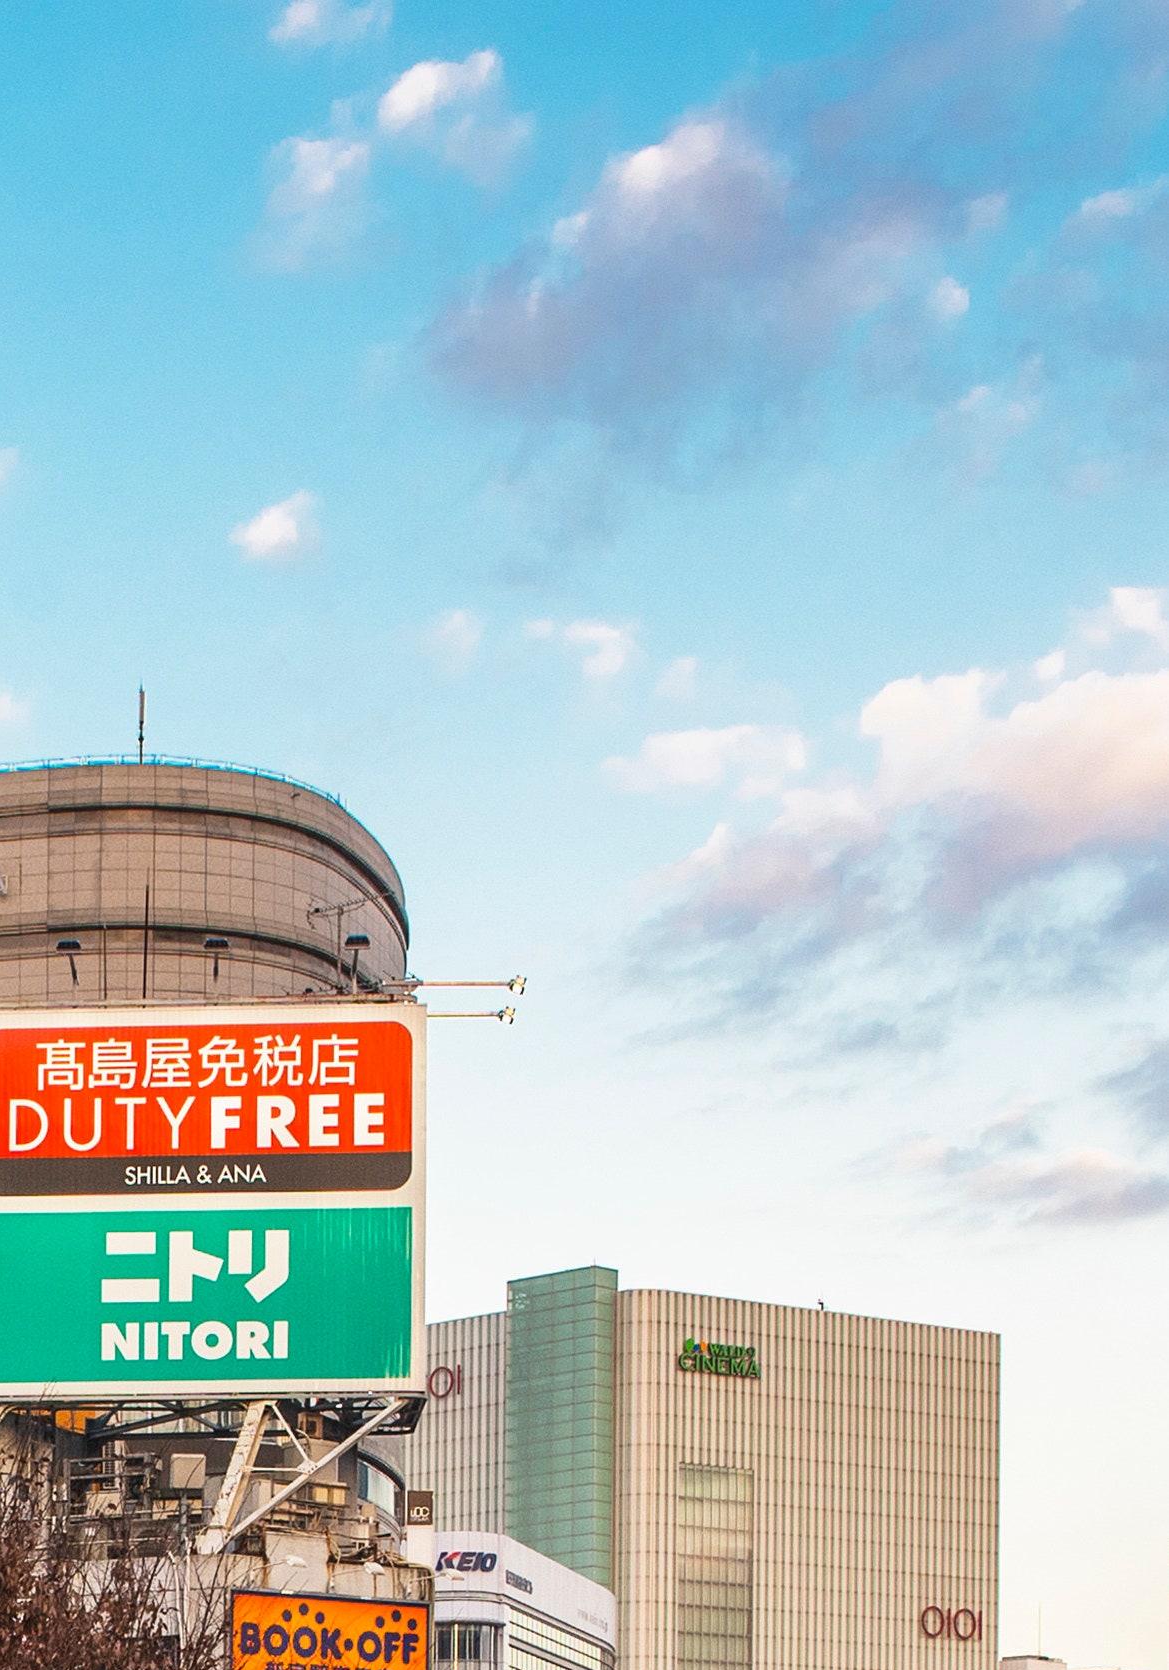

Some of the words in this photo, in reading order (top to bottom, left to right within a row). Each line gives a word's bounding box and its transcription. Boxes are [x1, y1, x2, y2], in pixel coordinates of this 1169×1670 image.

[124, 1165, 191, 1187] SHILLA
[197, 1164, 213, 1185] &
[217, 1163, 267, 1185] ANA
[100, 1228, 291, 1304] ニトリ
[100, 1320, 290, 1362] NITORI
[678, 1352, 762, 1380] CINEMA
[434, 1551, 498, 1573] KEIO
